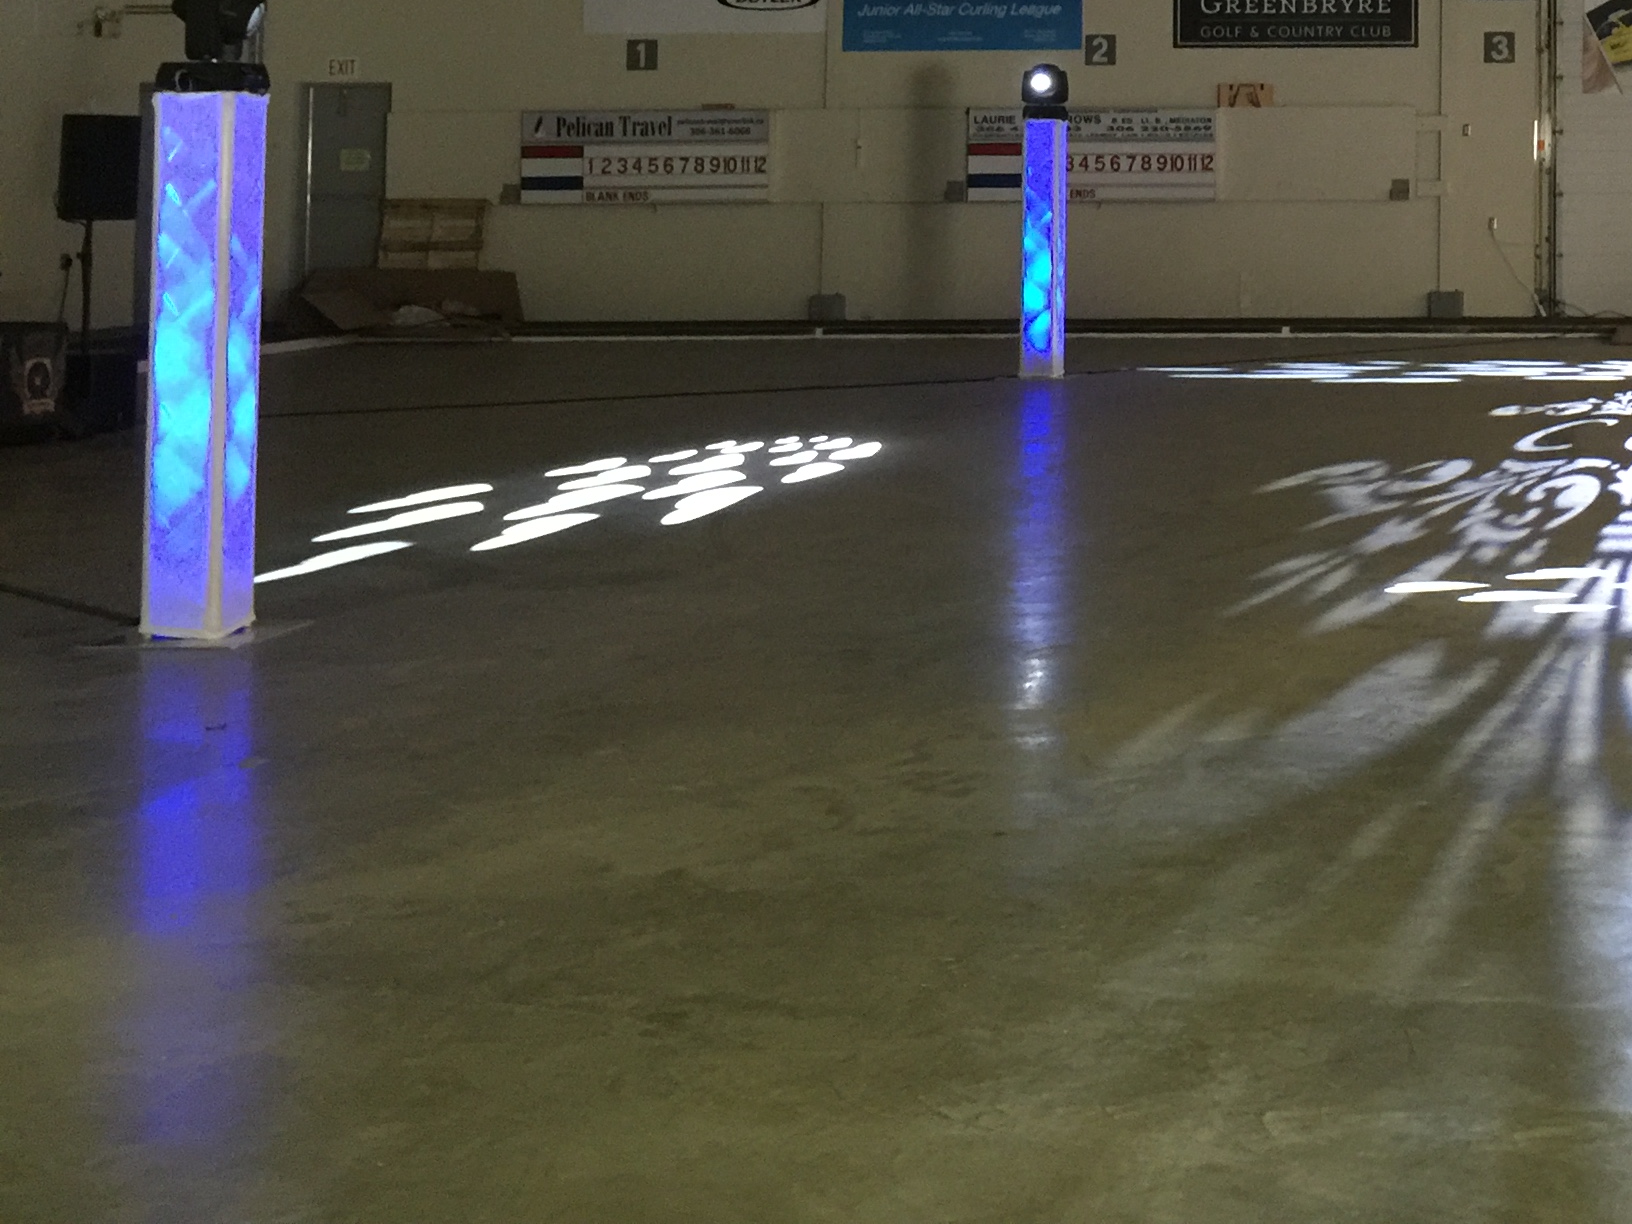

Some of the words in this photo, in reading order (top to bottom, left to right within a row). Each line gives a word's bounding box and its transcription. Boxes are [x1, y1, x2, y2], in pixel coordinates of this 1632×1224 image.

[857, 4, 901, 17] Junior
[903, 2, 954, 17] All-Star
[958, 2, 1008, 19] Curling
[1010, 3, 1062, 19] League
[1200, 25, 1243, 39] GOLF
[1250, 25, 1260, 38] &
[1267, 25, 1344, 39] COUNTRY
[1351, 25, 1392, 38] CLUB
[635, 42, 646, 68] 1
[1091, 38, 1109, 64] 2
[1490, 36, 1509, 62] 3
[328, 58, 356, 76] EXIT
[556, 116, 614, 138] Pelican
[619, 115, 673, 137] Travel
[973, 115, 1016, 124] LAURIE
[601, 156, 612, 175] 2
[617, 156, 628, 175] 3
[632, 156, 642, 175] 4
[648, 156, 658, 175] 5
[663, 156, 674, 175] 6
[679, 156, 690, 175] 7
[694, 156, 705, 175] 8
[710, 156, 720, 175] 9
[723, 156, 737, 175] 10
[741, 156, 750, 175] 11
[754, 156, 767, 175] 12
[1067, 154, 1074, 172] 3
[1079, 154, 1089, 172] 4
[1095, 154, 1105, 172] 5
[1110, 154, 1120, 172] 6
[1127, 154, 1137, 172] 7
[1141, 154, 1151, 172] 8
[1157, 154, 1167, 172] 9
[1170, 154, 1184, 172] 10
[1188, 154, 1197, 172] 11
[1201, 154, 1213, 172] 12
[585, 191, 620, 202] BLANK
[623, 191, 649, 202] ENDS
[1069, 189, 1096, 199] ENDS
